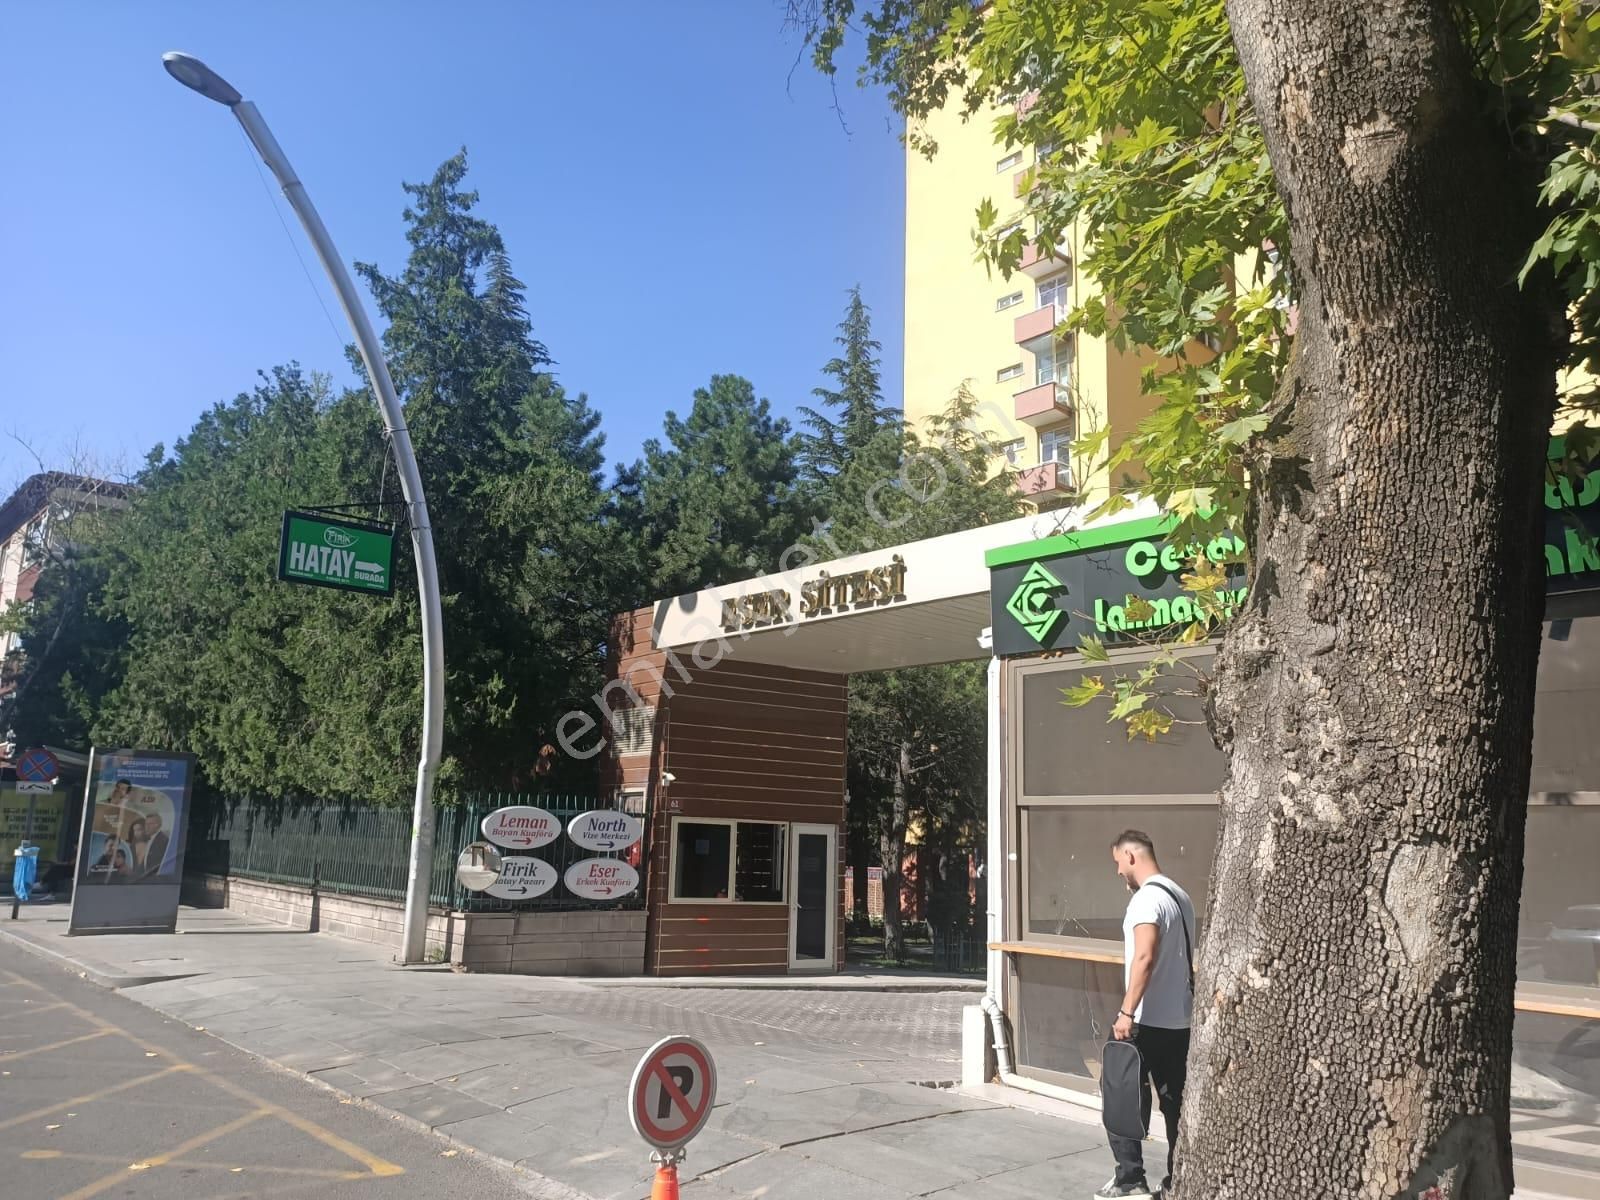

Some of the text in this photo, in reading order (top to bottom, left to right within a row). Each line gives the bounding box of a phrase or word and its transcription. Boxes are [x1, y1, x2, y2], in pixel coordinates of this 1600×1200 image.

[289, 541, 356, 578] HATAY
[354, 571, 385, 583] BURADA
[499, 813, 548, 830] Leman
[588, 817, 627, 832] North
[492, 828, 518, 838] Bayan
[582, 832, 631, 841] Vize Merkezi
[503, 861, 538, 877] Firik
[588, 863, 620, 878] Eser
[576, 878, 599, 886] Erkek
[657, 1065, 694, 1119] P
